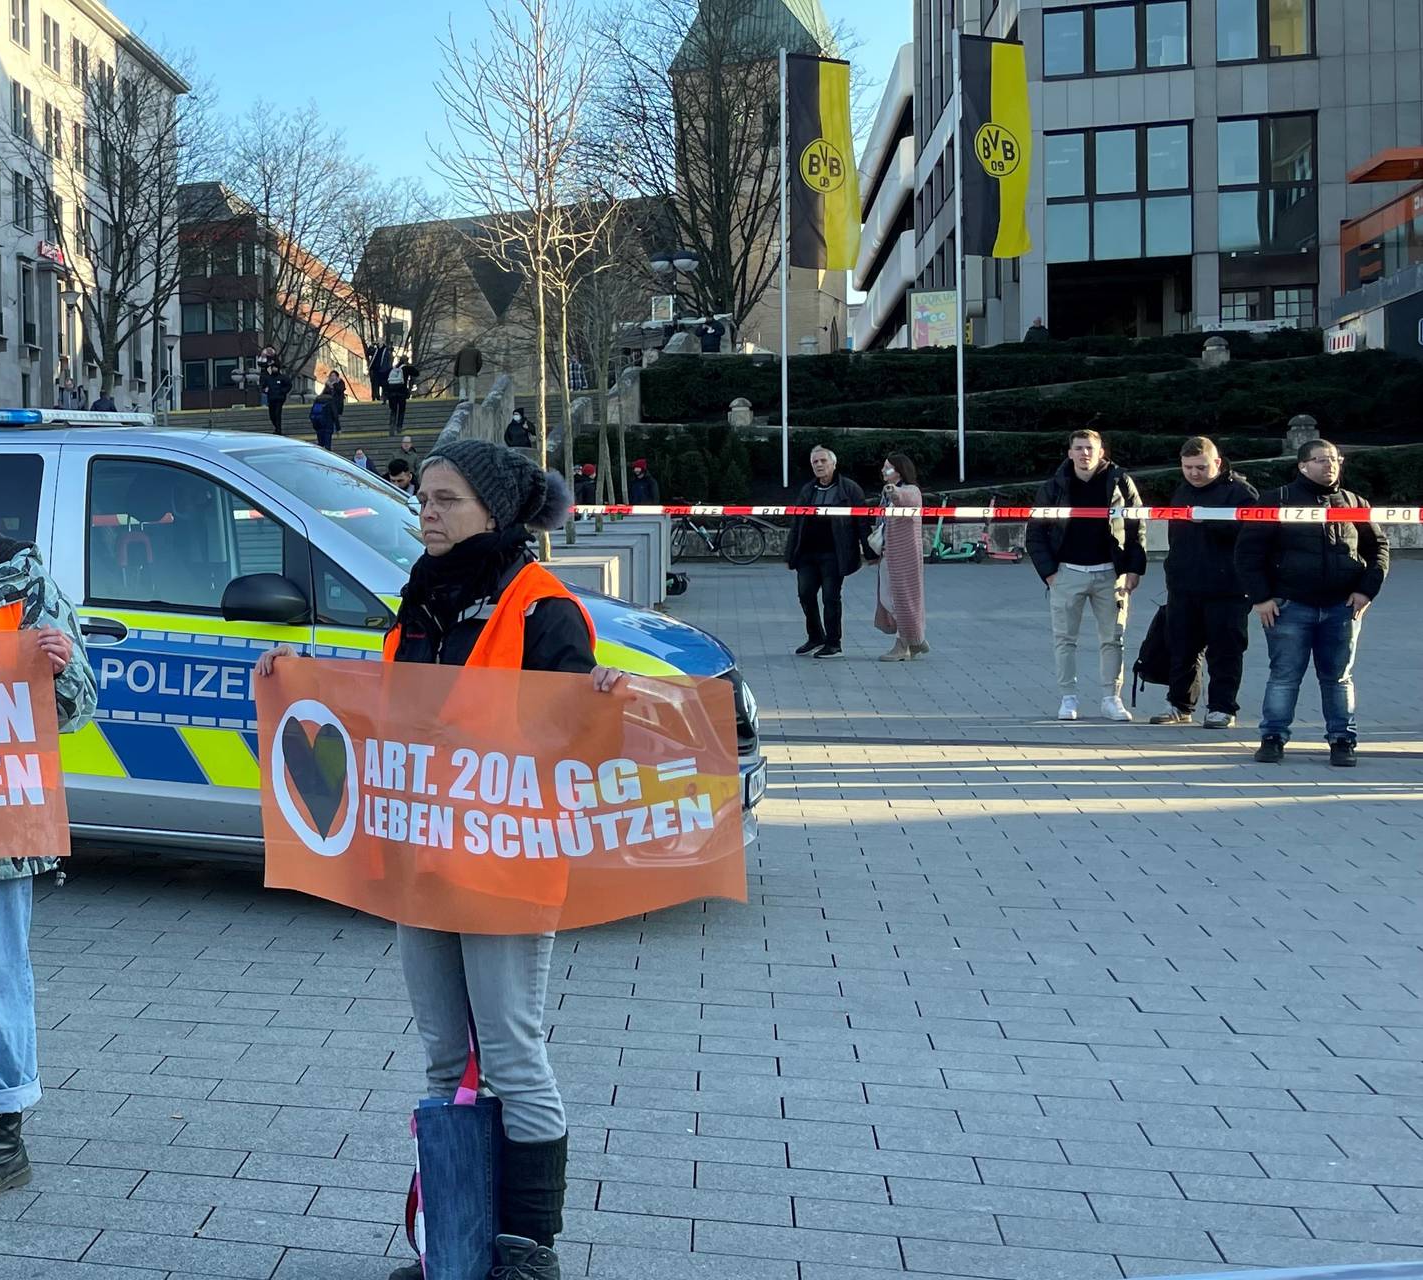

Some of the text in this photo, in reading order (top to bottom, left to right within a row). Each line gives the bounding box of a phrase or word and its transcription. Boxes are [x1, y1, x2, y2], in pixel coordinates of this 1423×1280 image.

[981, 130, 1016, 161] BVB
[808, 144, 842, 177] BVB
[990, 160, 1005, 172] 09
[867, 509, 939, 517] POLIZEI
[982, 509, 1062, 518] POLIZEI
[1108, 509, 1191, 519] POLIZEI
[1239, 509, 1329, 520] POLIZEI
[363, 738, 438, 794] ART.
[450, 748, 543, 810] 20A
[555, 758, 642, 811] GG
[364, 793, 715, 860] LEBEN SCHÜTZEN
